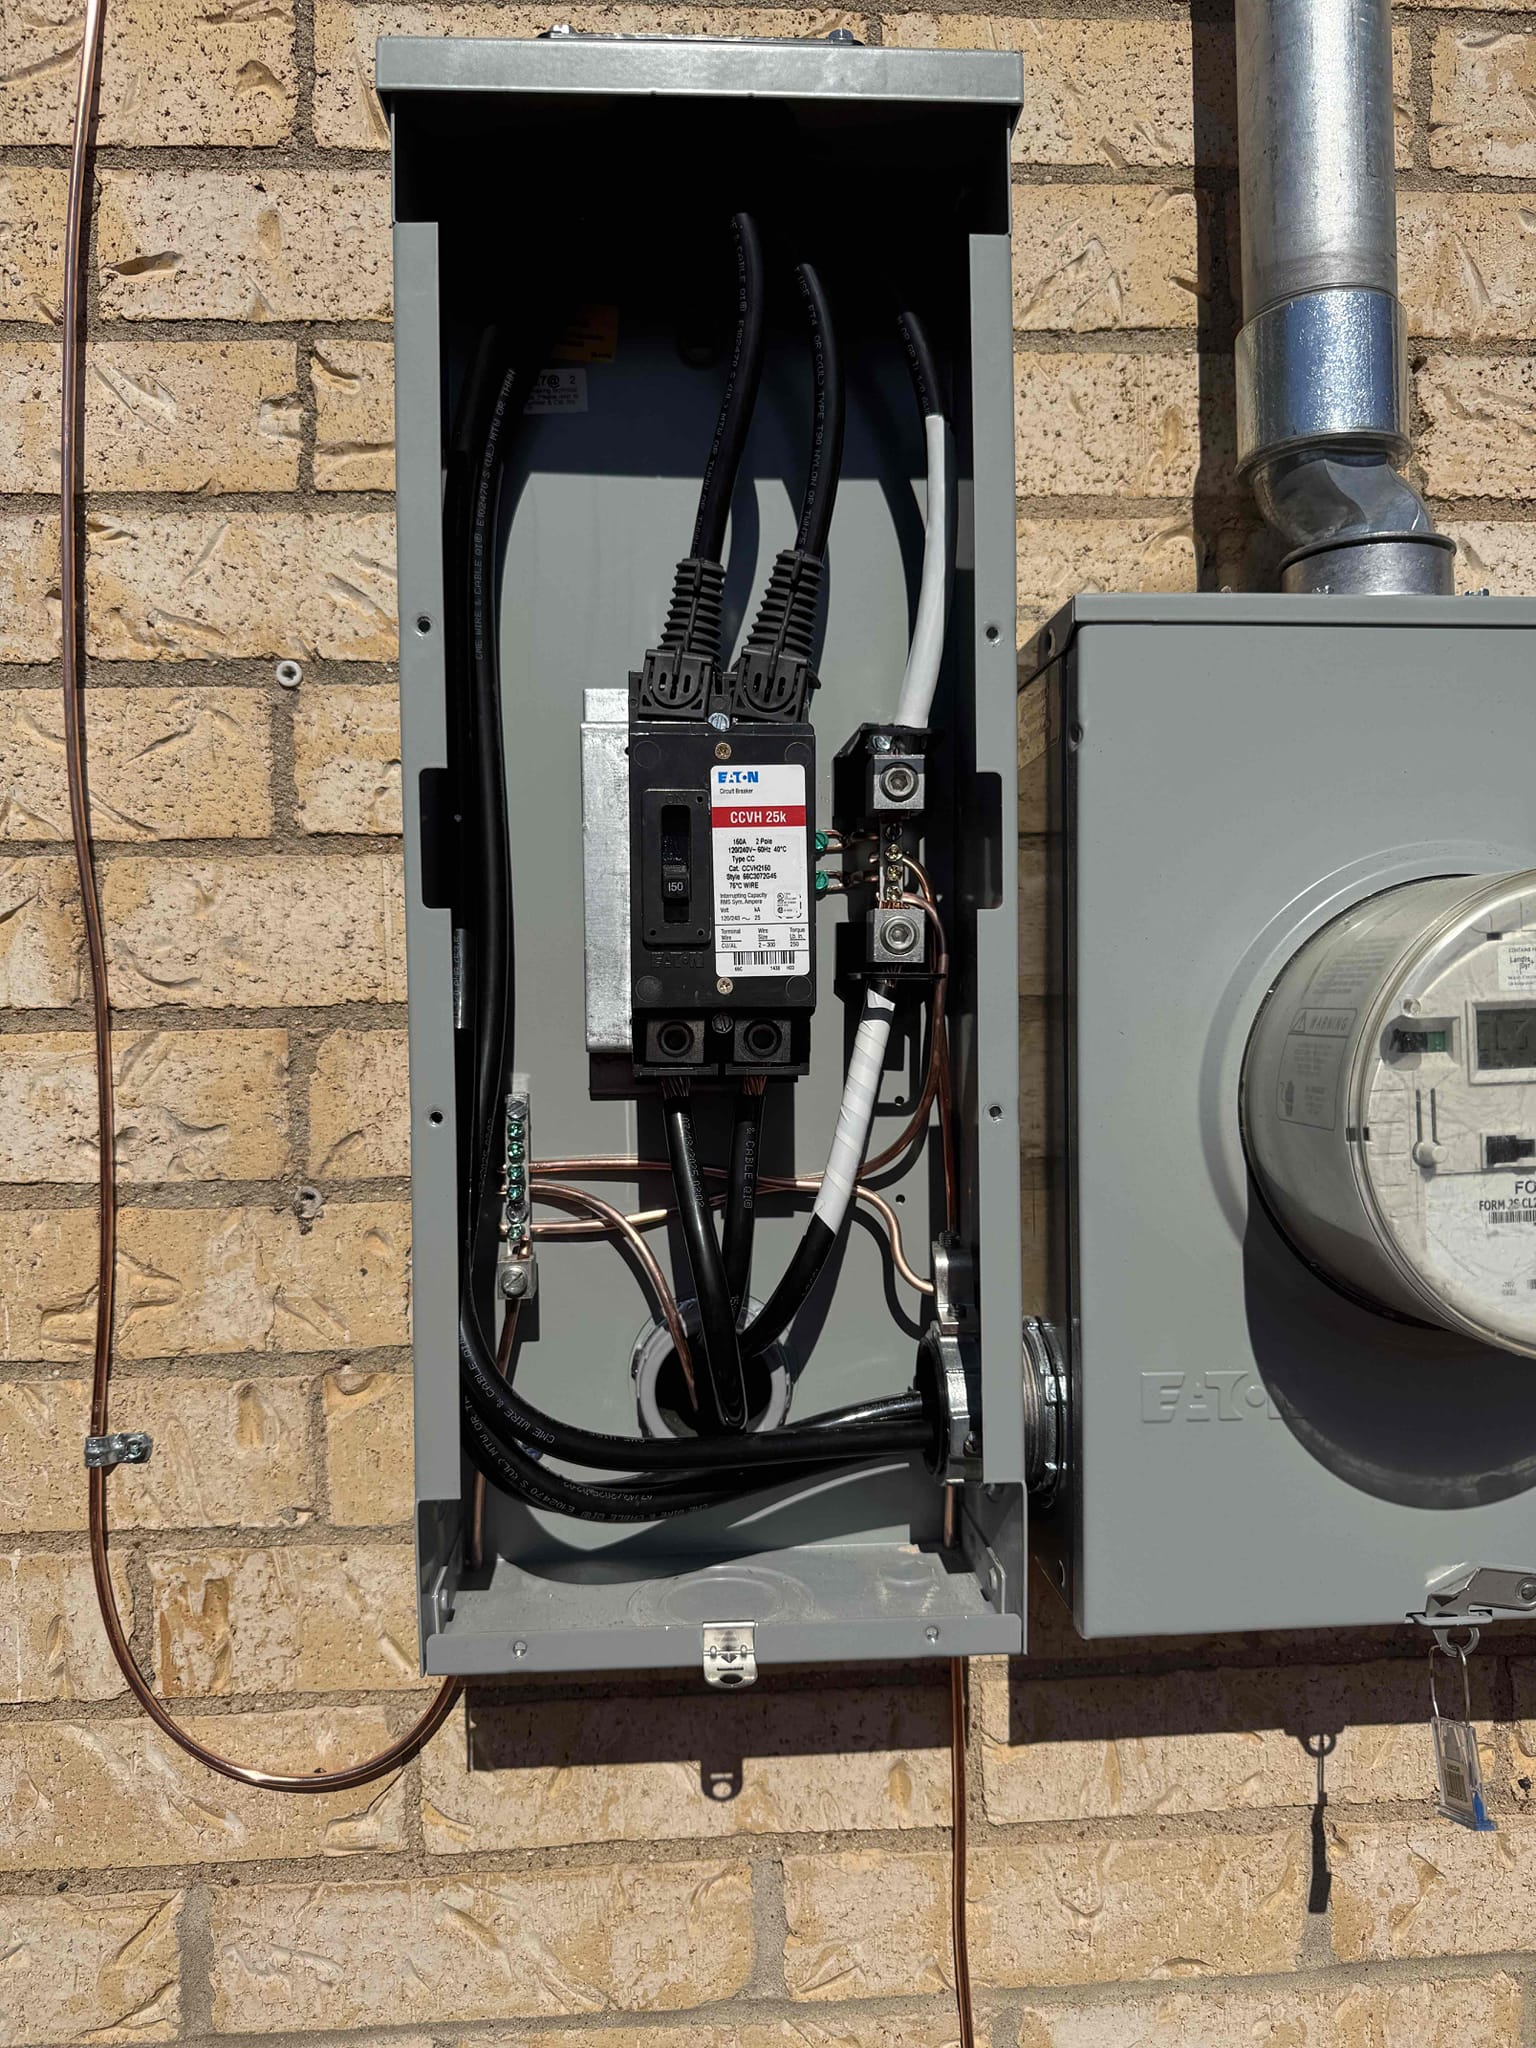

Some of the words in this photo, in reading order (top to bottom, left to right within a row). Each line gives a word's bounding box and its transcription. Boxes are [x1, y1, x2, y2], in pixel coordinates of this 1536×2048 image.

[569, 375, 576, 385] 2
[494, 400, 508, 416] OR
[817, 391, 825, 421] TYPE
[489, 416, 502, 441] MTW
[815, 424, 824, 446] T90
[809, 449, 821, 488] NYLON
[475, 481, 490, 527] E102470
[807, 490, 817, 505] OR
[473, 558, 483, 595] CABLE
[473, 610, 483, 636] WIRE
[474, 639, 484, 661] CME
[718, 771, 759, 784] EATON
[730, 811, 762, 824] CCVH
[766, 810, 787, 823] 25k
[760, 837, 773, 845] Pole
[773, 845, 787, 853] 40°C
[732, 855, 745, 864] Type
[668, 881, 684, 892] 150
[726, 873, 741, 882] Style
[720, 892, 746, 900] Interrupting
[747, 892, 767, 900] Capacity
[744, 1140, 755, 1180] CABLE
[1479, 1200, 1505, 1212] FORM
[468, 1359, 496, 1398] CABLE
[496, 1397, 505, 1408] &
[470, 1412, 484, 1431] OR
[503, 1408, 532, 1432] WIRE
[532, 1426, 556, 1444] CME
[479, 1433, 499, 1457] MTW
[497, 1457, 519, 1480] (UL)
[520, 1479, 529, 1489] S
[530, 1487, 576, 1514] E102470
